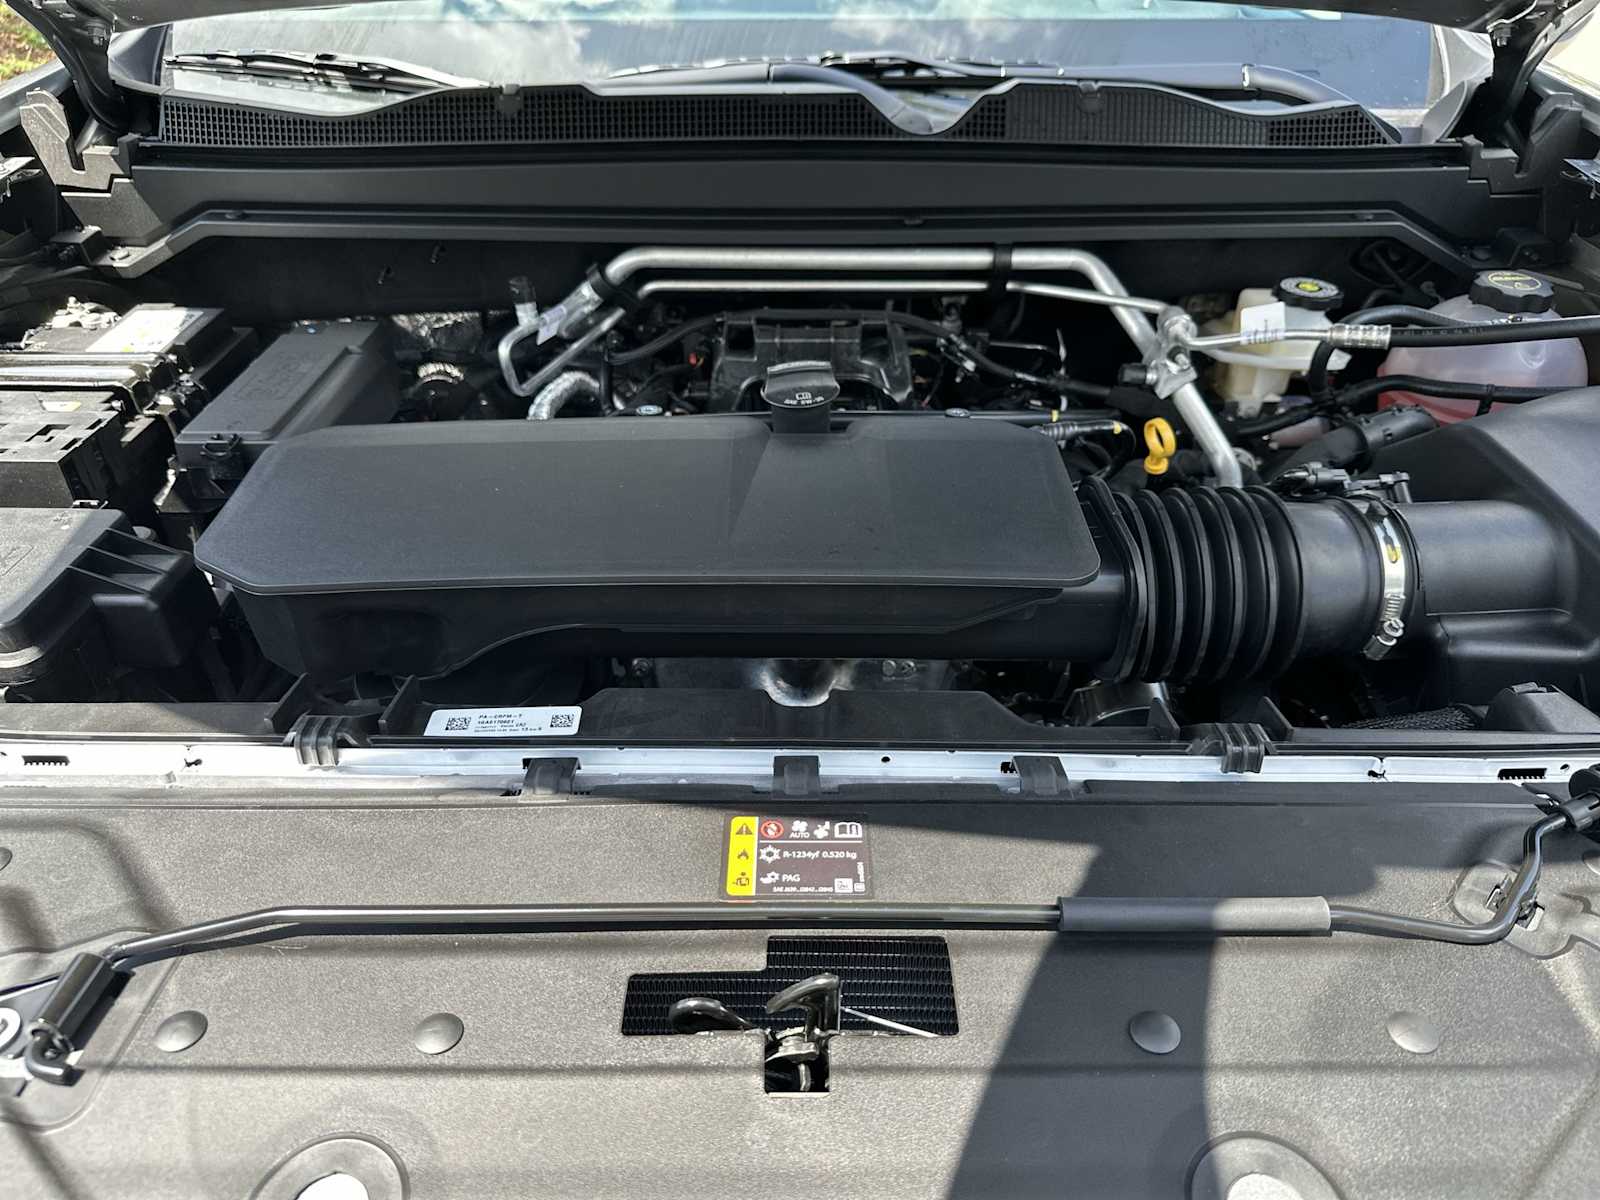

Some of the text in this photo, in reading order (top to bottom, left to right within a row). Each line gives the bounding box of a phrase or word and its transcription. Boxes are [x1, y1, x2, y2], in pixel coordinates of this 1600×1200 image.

[783, 851, 819, 860] R-1234yf
[846, 850, 856, 859] kg
[782, 874, 801, 882] PAG
